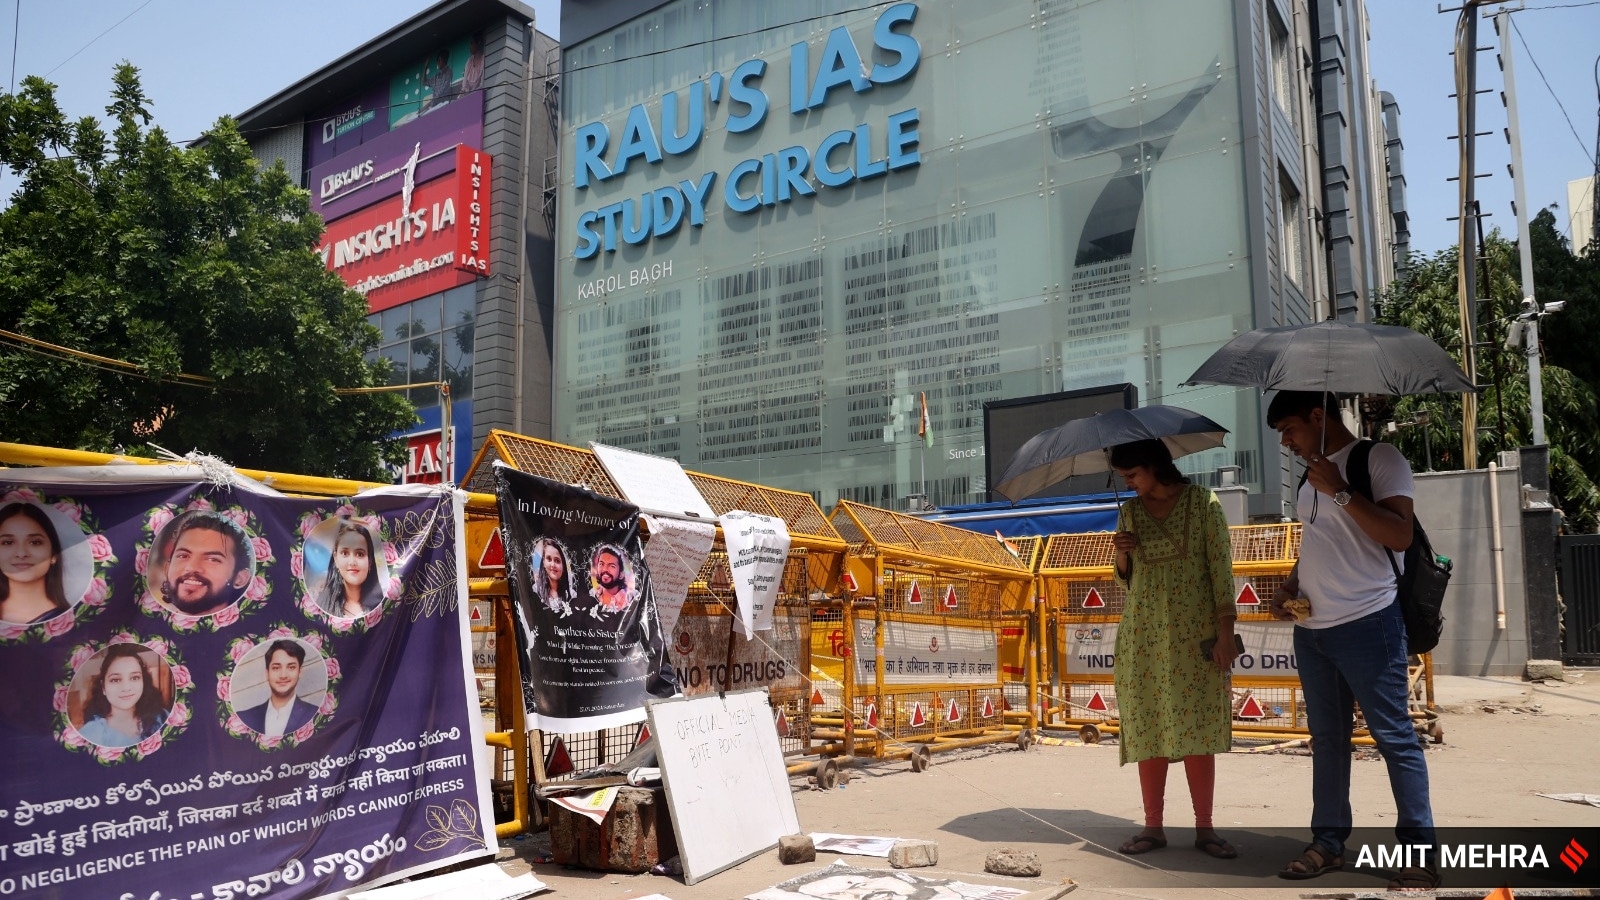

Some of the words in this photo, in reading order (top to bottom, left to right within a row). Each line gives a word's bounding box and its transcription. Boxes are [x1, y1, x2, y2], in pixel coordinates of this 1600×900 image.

[574, 59, 769, 190] RAU'S
[790, 2, 921, 115] IAS
[336, 105, 362, 126] BYJU'S
[337, 120, 355, 134] TUITION
[355, 110, 375, 125] CENTRE
[334, 160, 374, 190] BYJU'S
[573, 171, 718, 260] STUDY
[724, 107, 922, 213] CIRCLE
[470, 152, 482, 252] INSIGHTS
[333, 208, 427, 268] INSIGHTS
[432, 198, 456, 231] IA
[461, 254, 487, 270] IAS
[578, 274, 626, 301] KAROL
[630, 260, 673, 287] BAGH
[949, 448, 977, 460] Since
[518, 499, 530, 512] In
[532, 501, 574, 525] Loving
[575, 509, 615, 531] Memory
[619, 518, 633, 530] of
[553, 626, 587, 638] Brothers
[587, 628, 596, 638] &
[596, 628, 625, 639] Sisters
[676, 666, 702, 688] NO
[706, 664, 729, 686] TO
[885, 660, 896, 673] का
[898, 656, 904, 674] है
[906, 656, 930, 674] अभियान
[932, 661, 945, 674] नशा
[968, 662, 976, 674] हर
[1079, 654, 1116, 669] “IND
[1261, 654, 1299, 669] DRU
[675, 713, 724, 740] OFFICIAL
[13, 830, 56, 858] खोई
[60, 825, 88, 857] हुई
[177, 804, 239, 827] जिसका
[241, 795, 264, 816] दर्द
[266, 786, 302, 810] शब्दों
[304, 784, 318, 804] में
[347, 773, 374, 794] नहीं
[375, 765, 410, 787] किया
[411, 762, 425, 777] जा
[0, 878, 16, 895] O
[21, 851, 146, 891] NEGLIGENCE
[148, 843, 183, 863] THE
[186, 834, 226, 855] PAIN
[229, 829, 250, 846] OF
[254, 818, 308, 841] WHICH
[311, 804, 357, 828] WORDS
[358, 791, 413, 815] CANNOT
[414, 778, 465, 800] EXPRESS
[313, 832, 408, 882] న్యాయం
